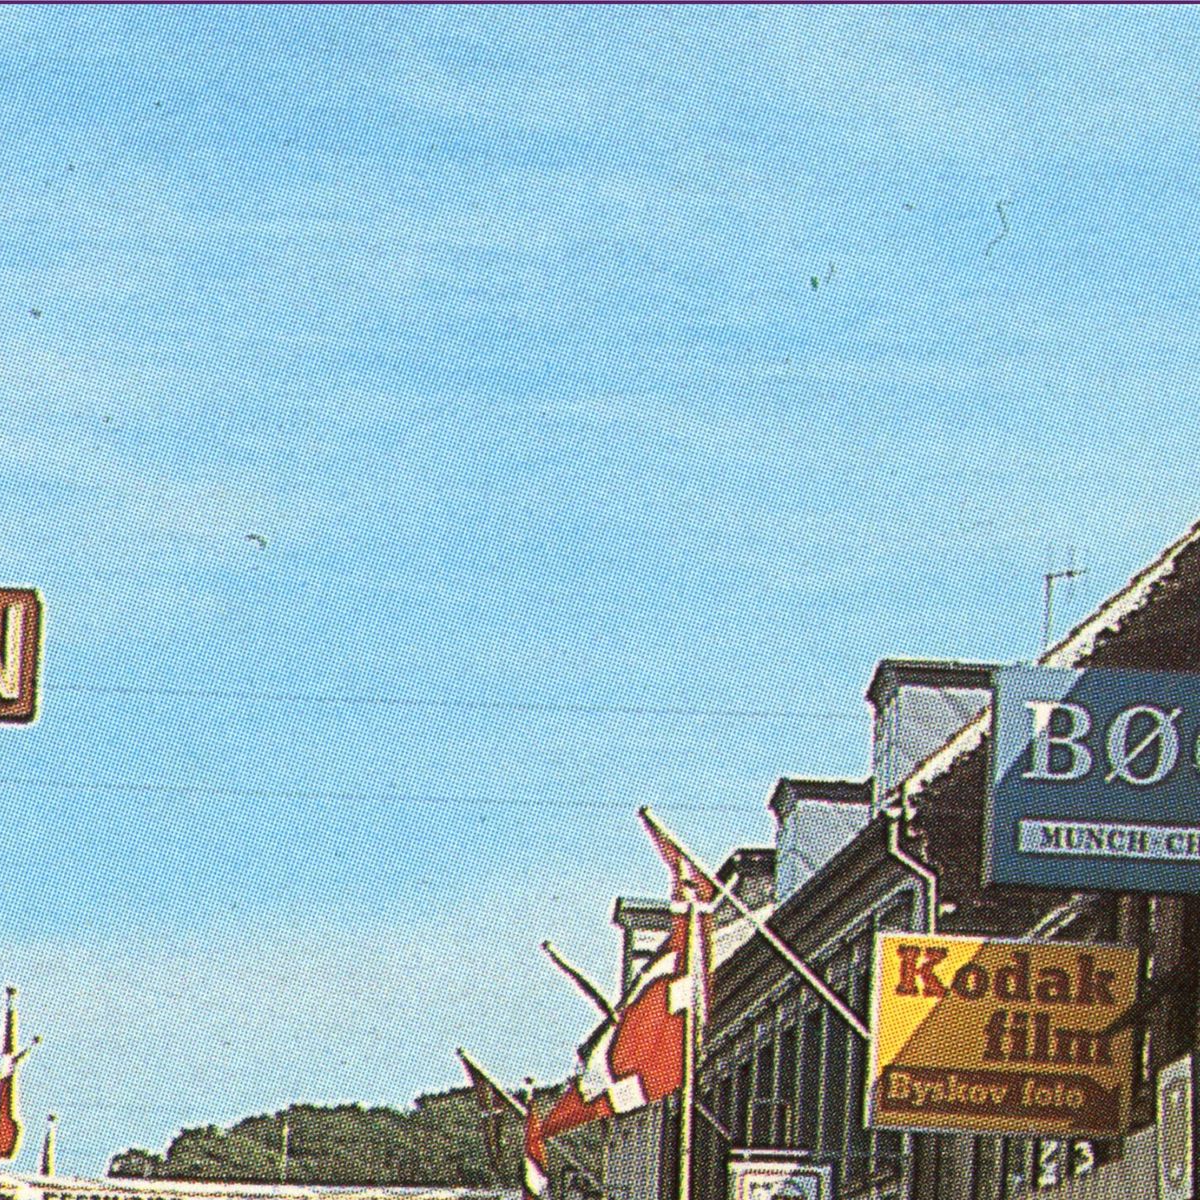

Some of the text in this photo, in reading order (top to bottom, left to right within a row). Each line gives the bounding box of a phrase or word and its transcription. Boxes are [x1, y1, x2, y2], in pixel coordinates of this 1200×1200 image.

[1021, 700, 1200, 786] BØ
[896, 943, 1116, 1005] Kodak
[982, 1008, 1113, 1065] film
